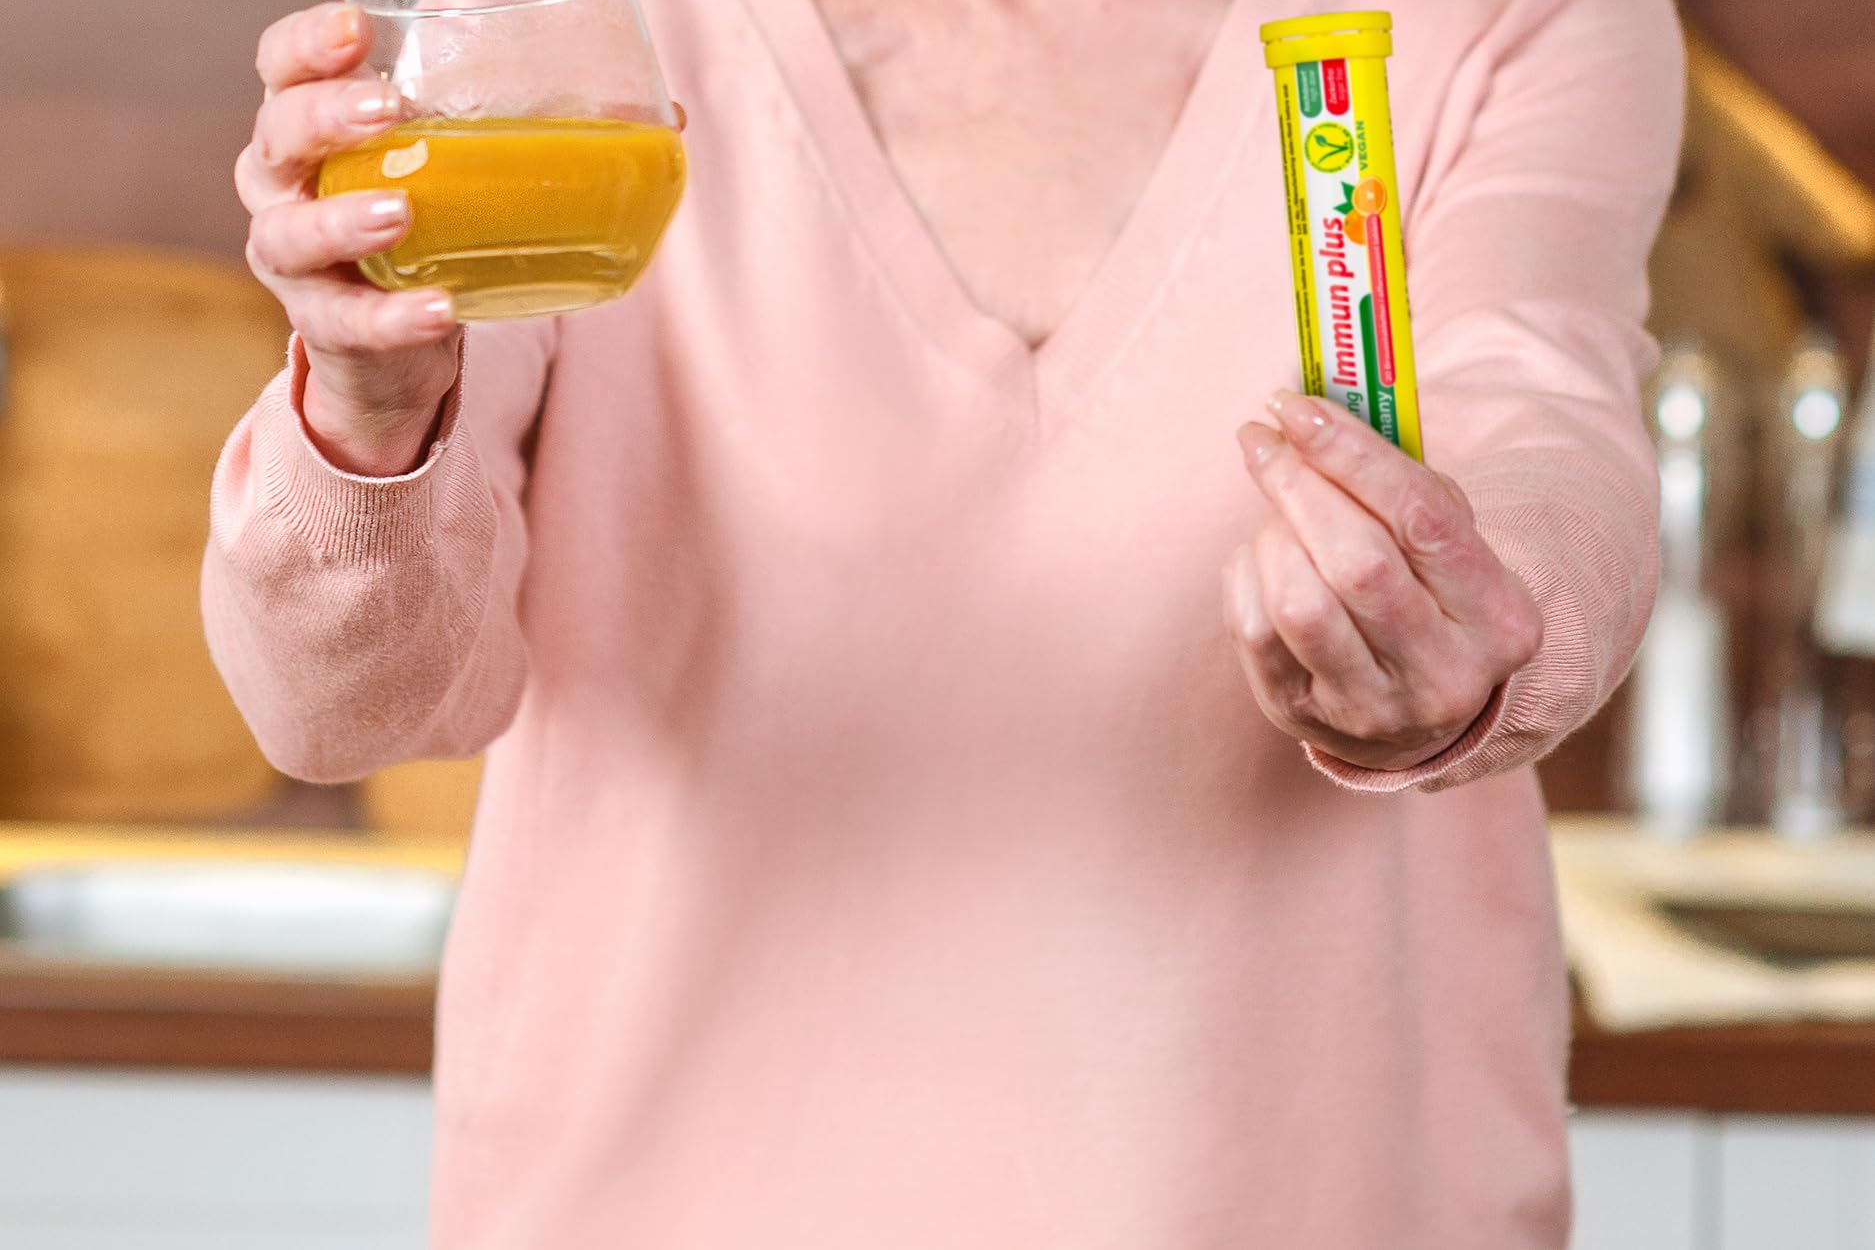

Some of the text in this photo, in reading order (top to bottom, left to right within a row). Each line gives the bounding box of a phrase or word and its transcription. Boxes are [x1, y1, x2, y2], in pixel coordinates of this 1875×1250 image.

[1356, 120, 1368, 170] VEGAN
[1319, 217, 1364, 417] ng Immun plus
